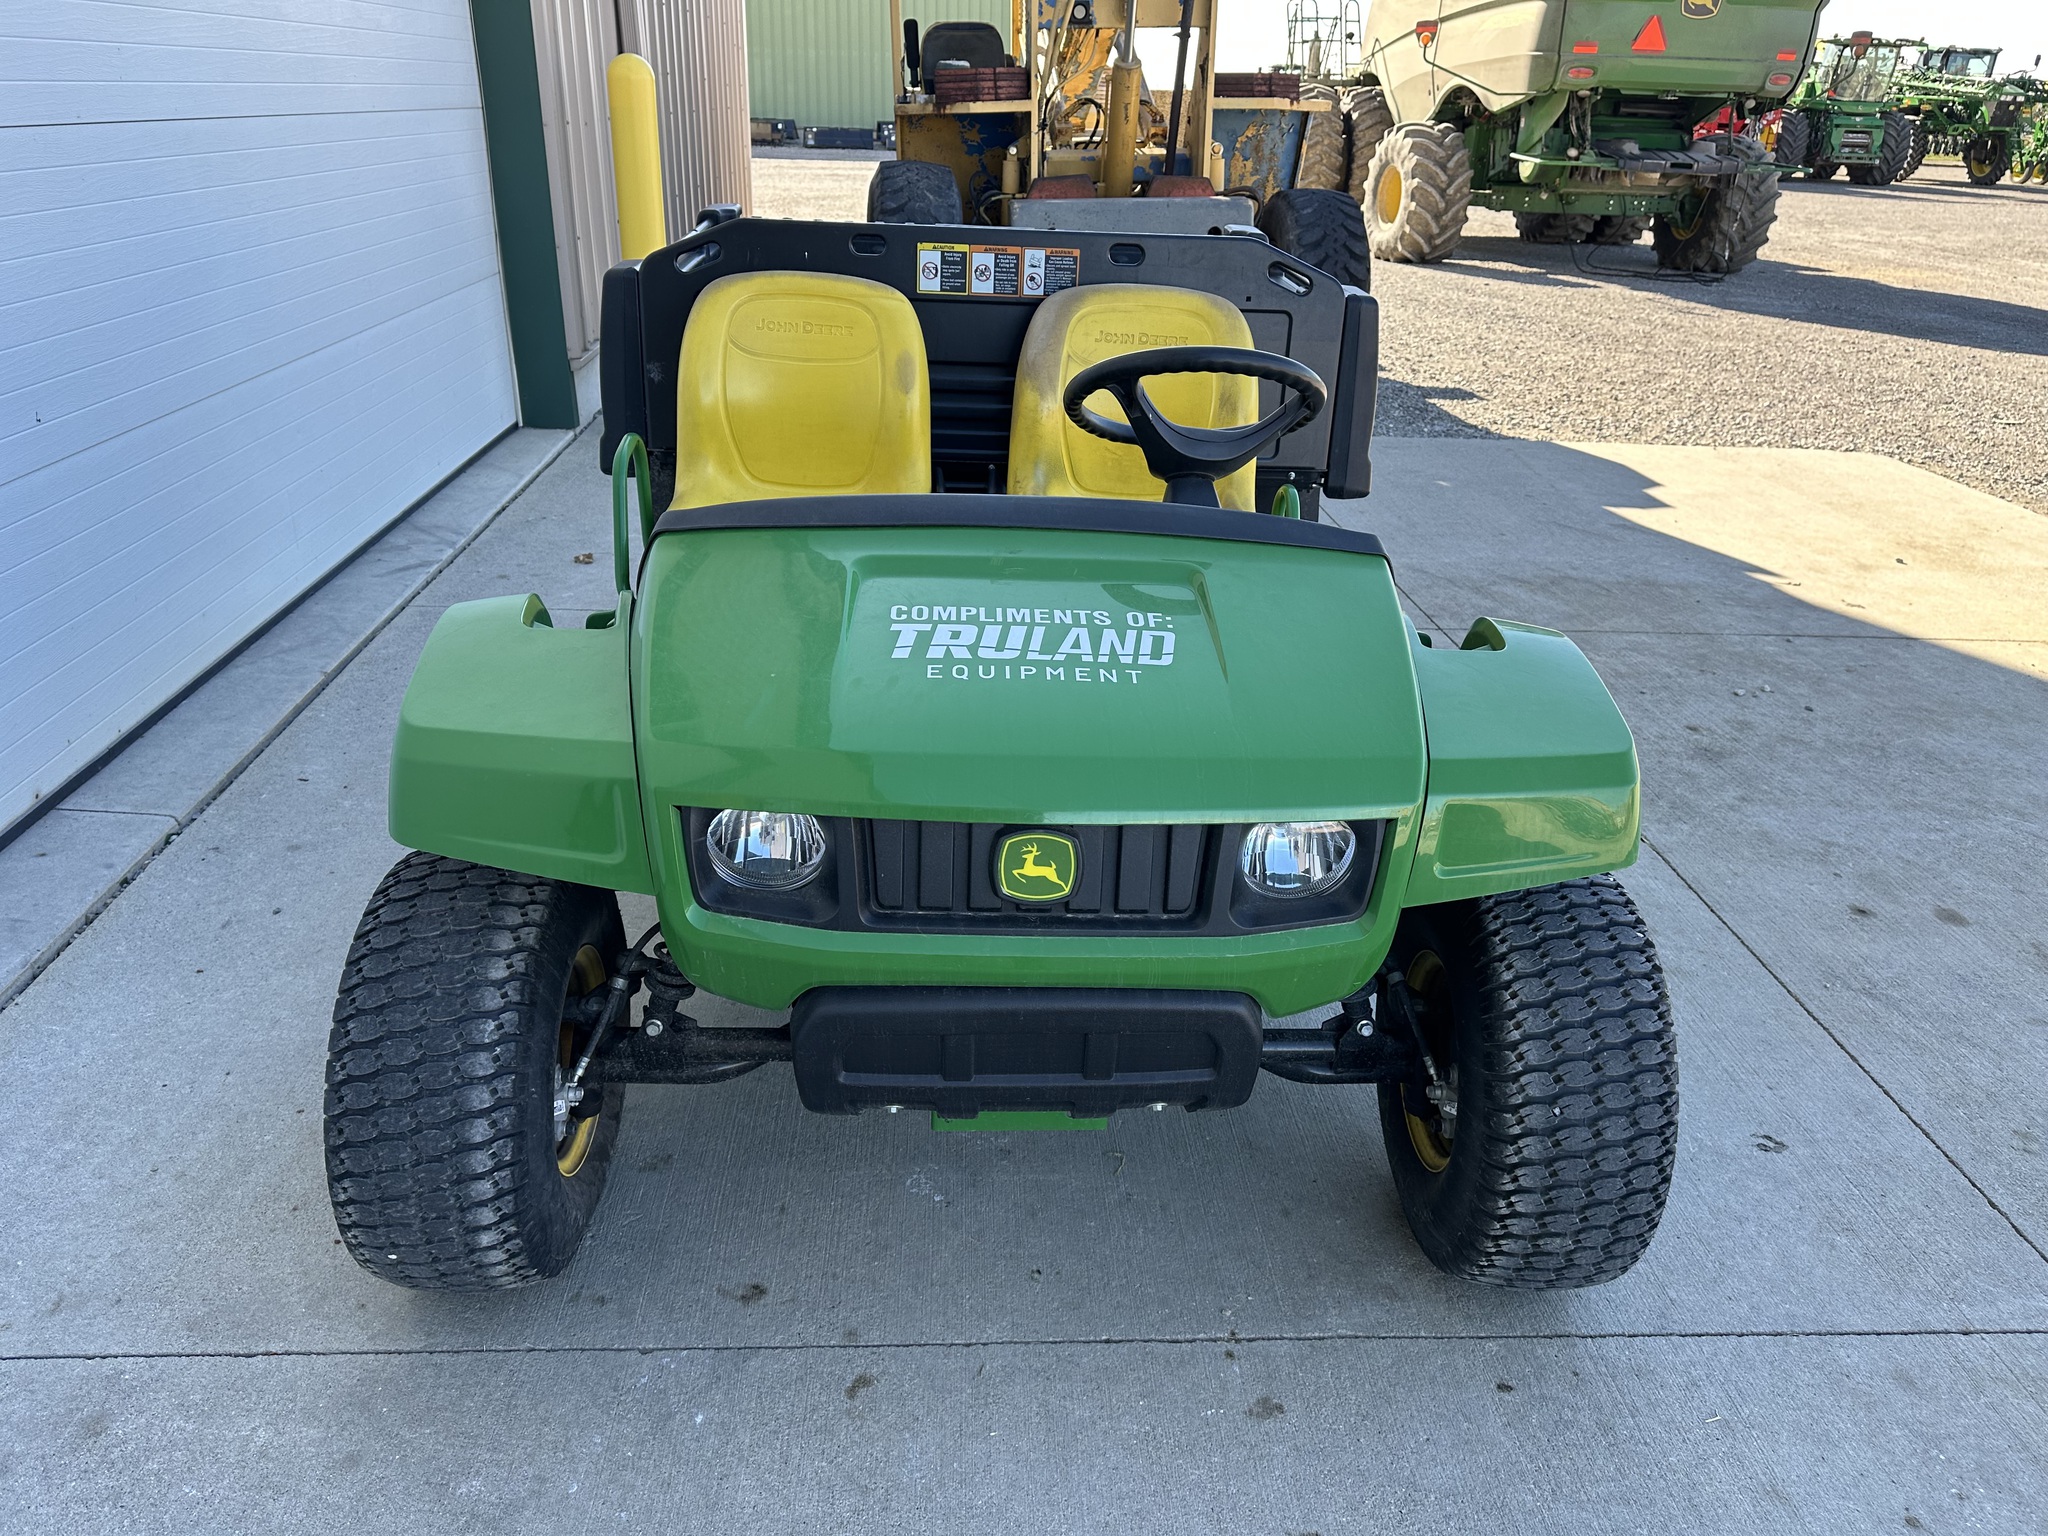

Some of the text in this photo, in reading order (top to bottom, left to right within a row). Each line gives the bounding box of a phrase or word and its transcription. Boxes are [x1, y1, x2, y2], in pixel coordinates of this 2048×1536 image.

[756, 318, 854, 337] JOHN DEERE
[1094, 330, 1189, 346] JOHN DEERE
[890, 605, 1174, 629] COMPLIMENTS OF:
[889, 623, 1176, 666] TRULAND
[926, 664, 1142, 684] EQUIPMENT
